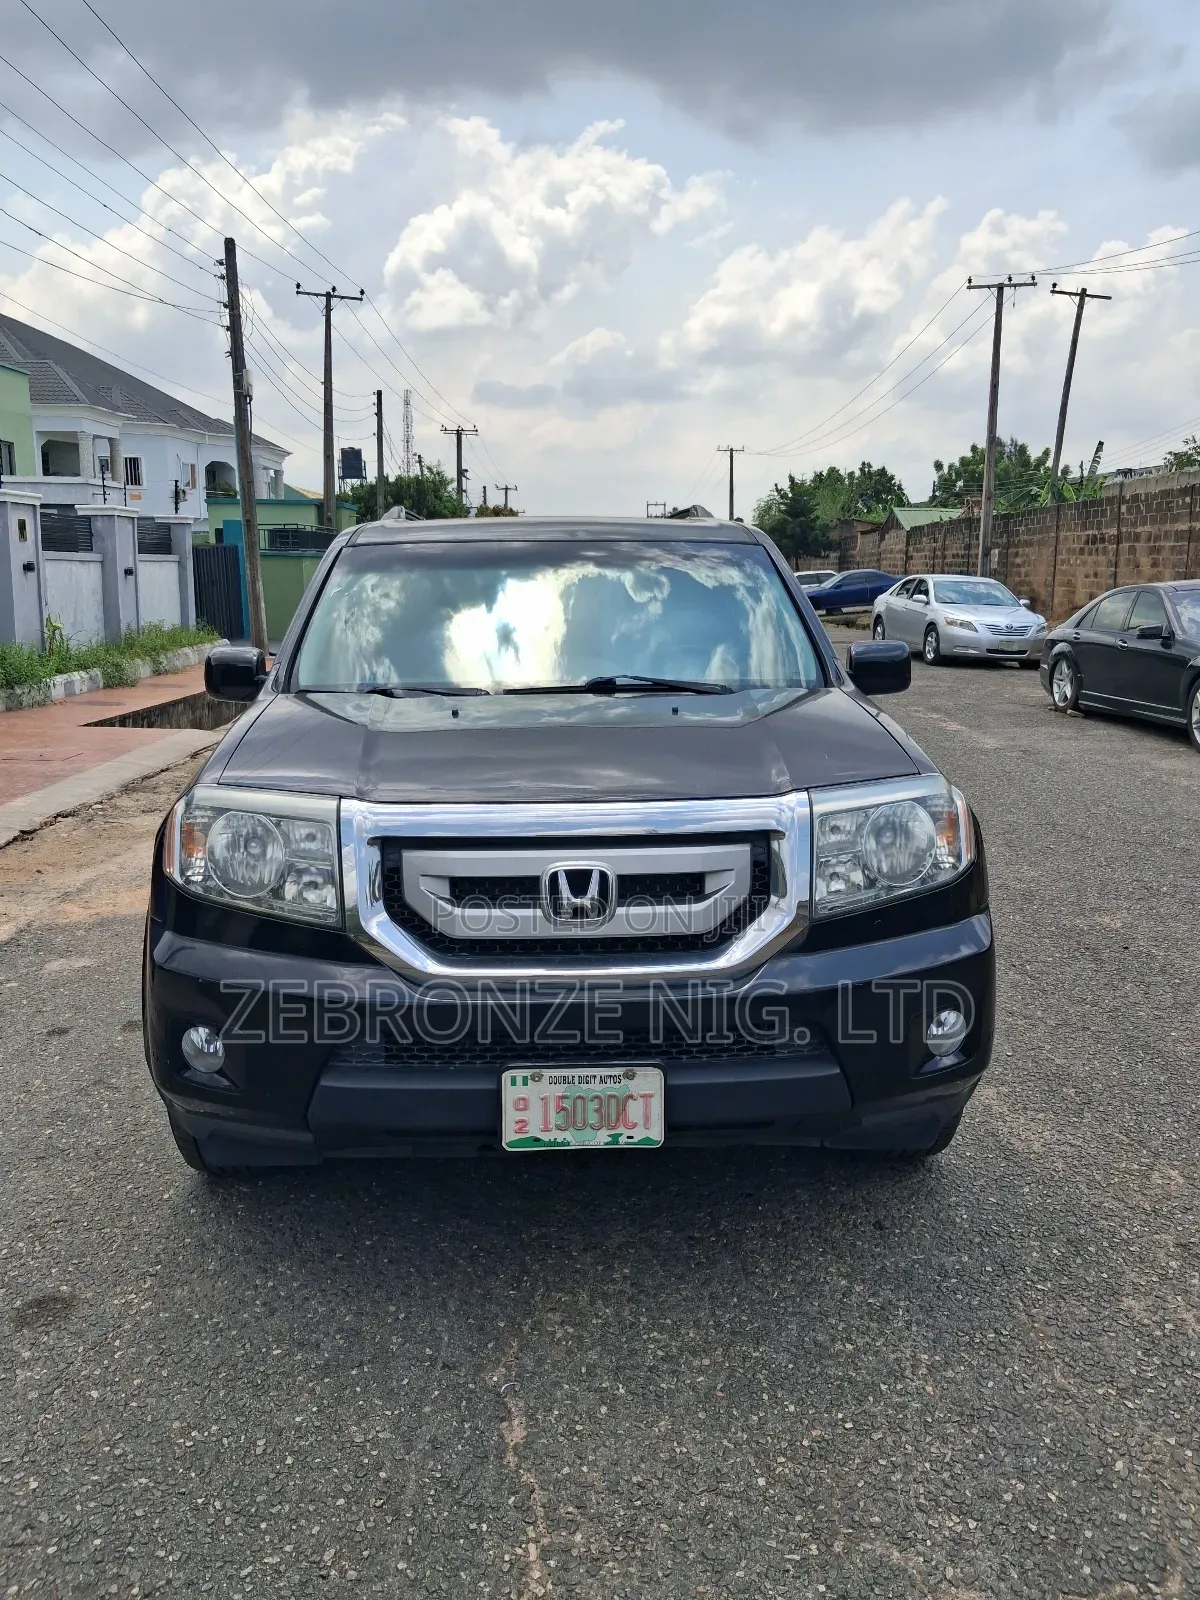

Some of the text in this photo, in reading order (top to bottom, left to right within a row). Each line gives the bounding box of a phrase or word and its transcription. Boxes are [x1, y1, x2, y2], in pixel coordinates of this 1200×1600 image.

[548, 1074, 622, 1085] DOUBLE DIGIT AUTOS
[539, 1091, 654, 1132] 1503DCT
